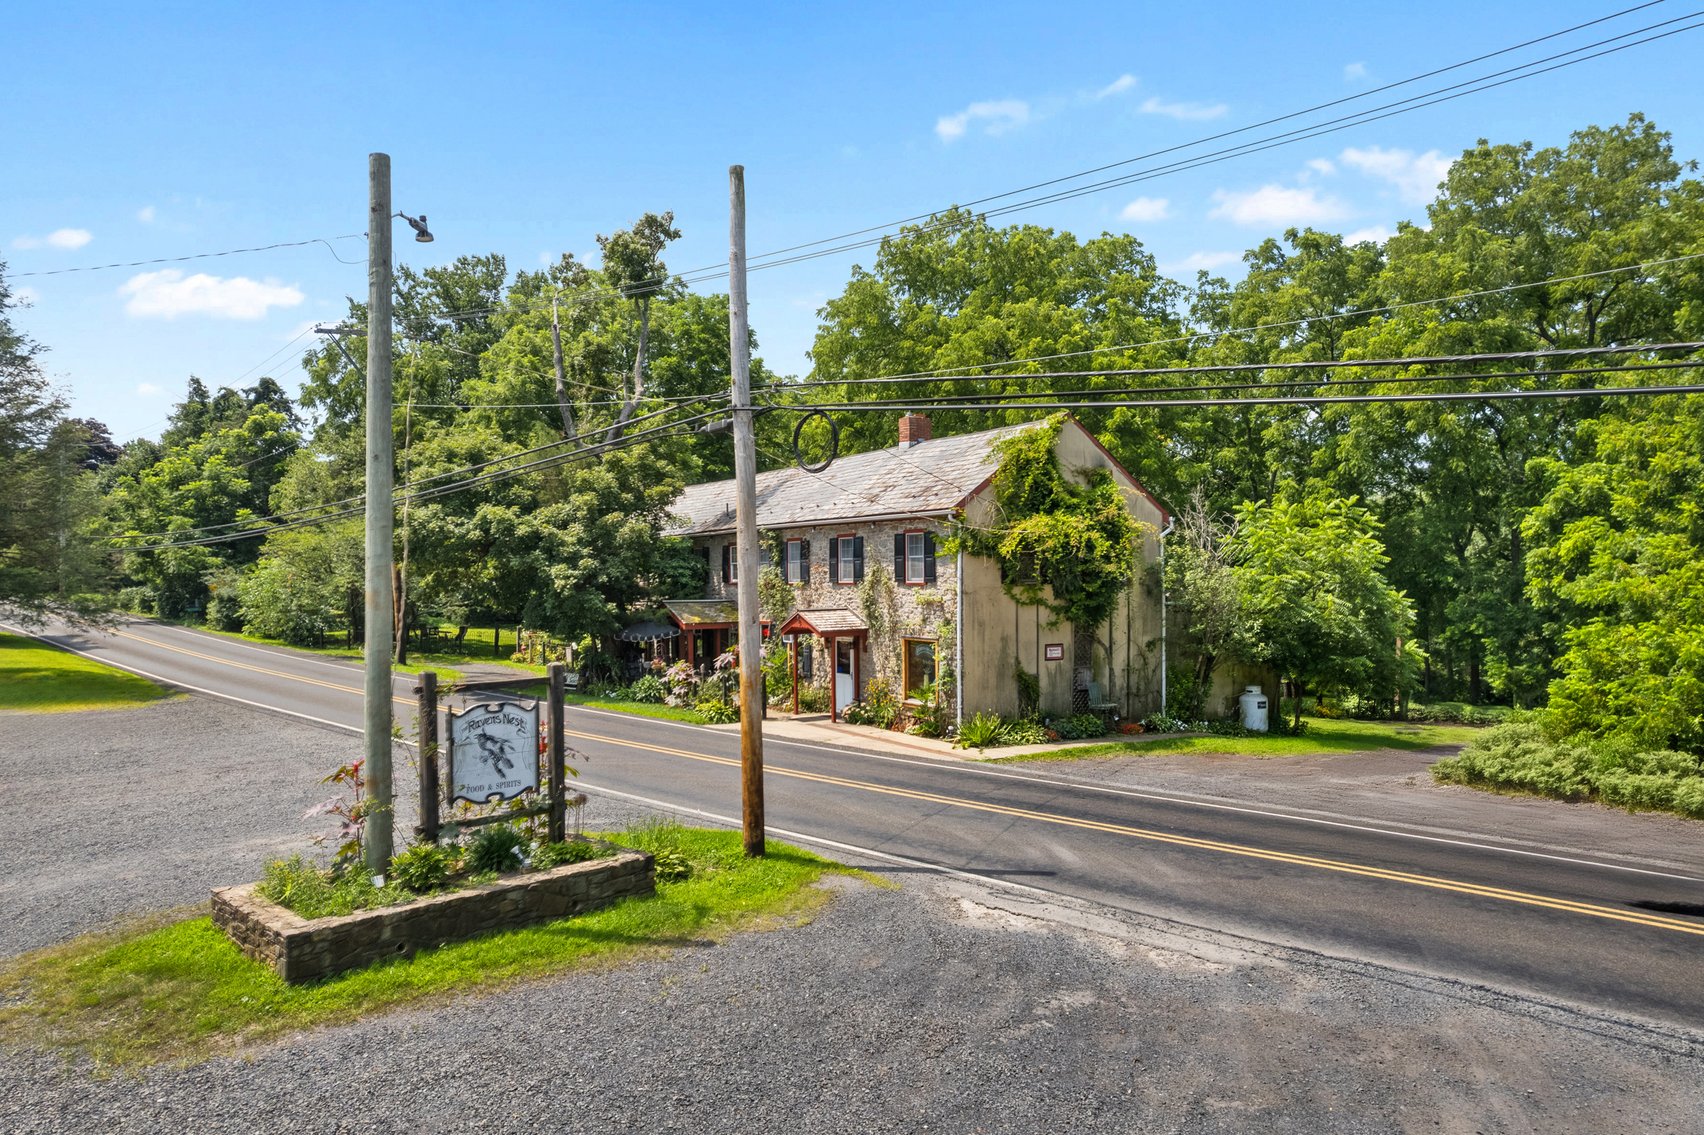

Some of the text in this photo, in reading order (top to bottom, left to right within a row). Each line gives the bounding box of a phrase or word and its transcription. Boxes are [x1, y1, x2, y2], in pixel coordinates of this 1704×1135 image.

[502, 713, 526, 730] Nest
[466, 779, 522, 794] FOOD & SPIRITS
